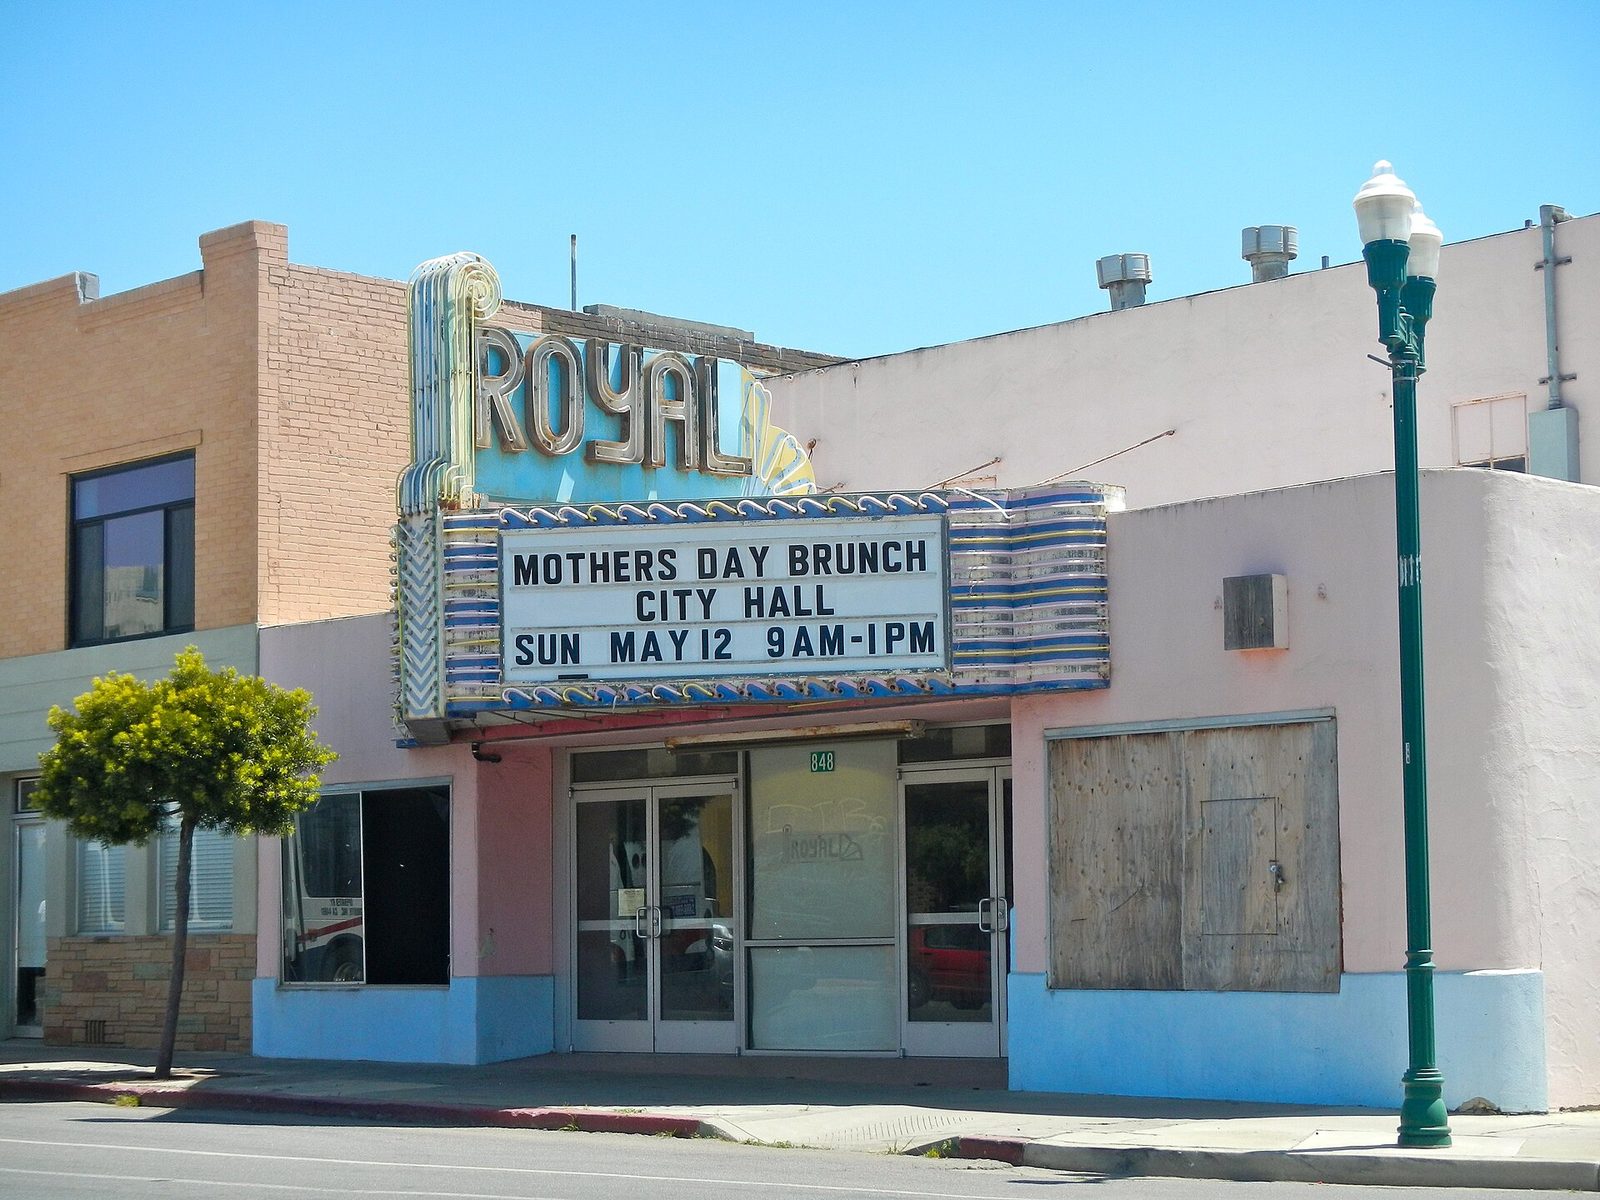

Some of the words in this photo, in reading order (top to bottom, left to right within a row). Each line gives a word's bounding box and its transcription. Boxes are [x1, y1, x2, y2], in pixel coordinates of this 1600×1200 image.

[474, 327, 753, 476] ROYAL
[513, 549, 678, 586] MOTHERS
[697, 546, 770, 580] DAY
[788, 540, 927, 576] BRUNCH
[636, 588, 718, 622] CITY
[744, 584, 835, 618] HALL
[515, 633, 580, 666] SUN
[610, 629, 690, 663] MAY
[701, 628, 732, 660] 12
[766, 621, 935, 658] 9AM-1PM
[811, 752, 834, 772] 848
[791, 836, 839, 859] ROYAL
